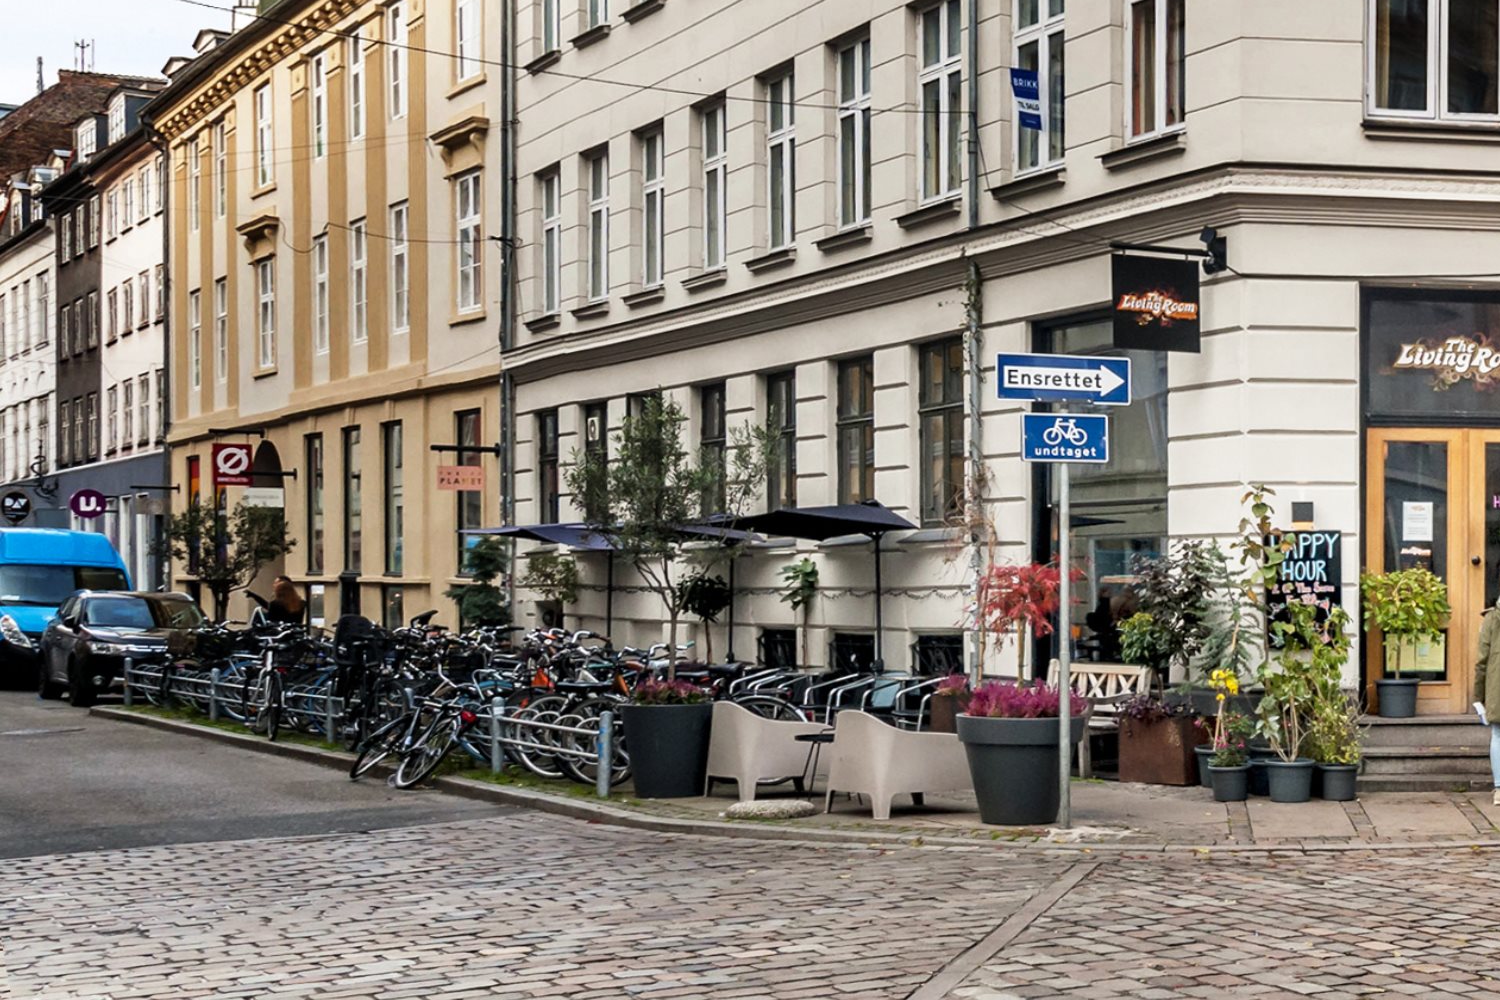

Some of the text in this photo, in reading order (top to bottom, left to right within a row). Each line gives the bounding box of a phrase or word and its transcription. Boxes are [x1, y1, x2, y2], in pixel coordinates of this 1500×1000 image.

[1122, 295, 1196, 316] Living Room
[1445, 339, 1475, 353] The
[1398, 344, 1473, 373] Living
[1007, 369, 1102, 389] Ensrettet
[1034, 447, 1097, 458] undtaget
[1270, 533, 1339, 559] APPY
[1282, 560, 1327, 582] HOUR
